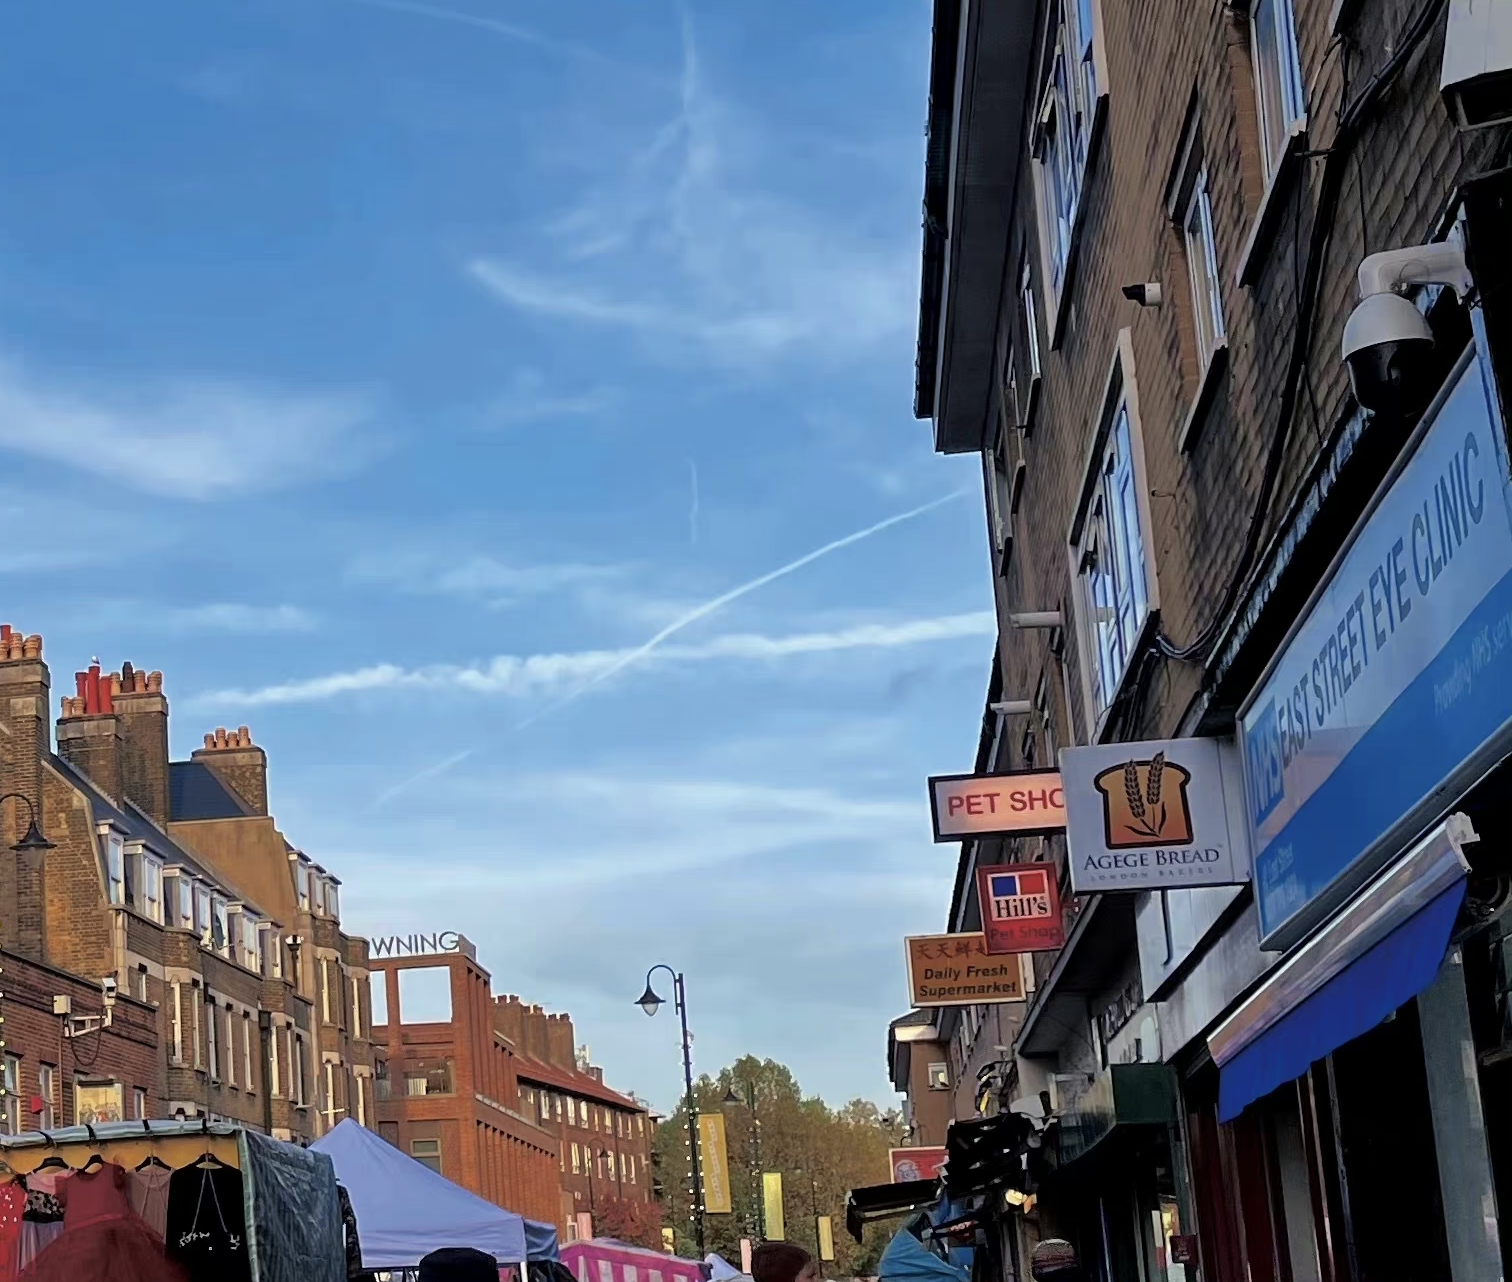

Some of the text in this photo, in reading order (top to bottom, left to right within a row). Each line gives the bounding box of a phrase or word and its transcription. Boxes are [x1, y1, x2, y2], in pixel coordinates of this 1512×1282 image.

[1279, 672, 1312, 770] EAST
[1312, 589, 1369, 728] STREET
[1369, 536, 1412, 653] EYE
[1412, 432, 1485, 597] CLINIC
[948, 788, 1065, 817] PET SHO
[1084, 848, 1220, 871] AGEGE BREAD
[994, 897, 1048, 918] Hill's
[924, 964, 1008, 982] Daily Fresh
[919, 981, 1017, 999] Supermarket
